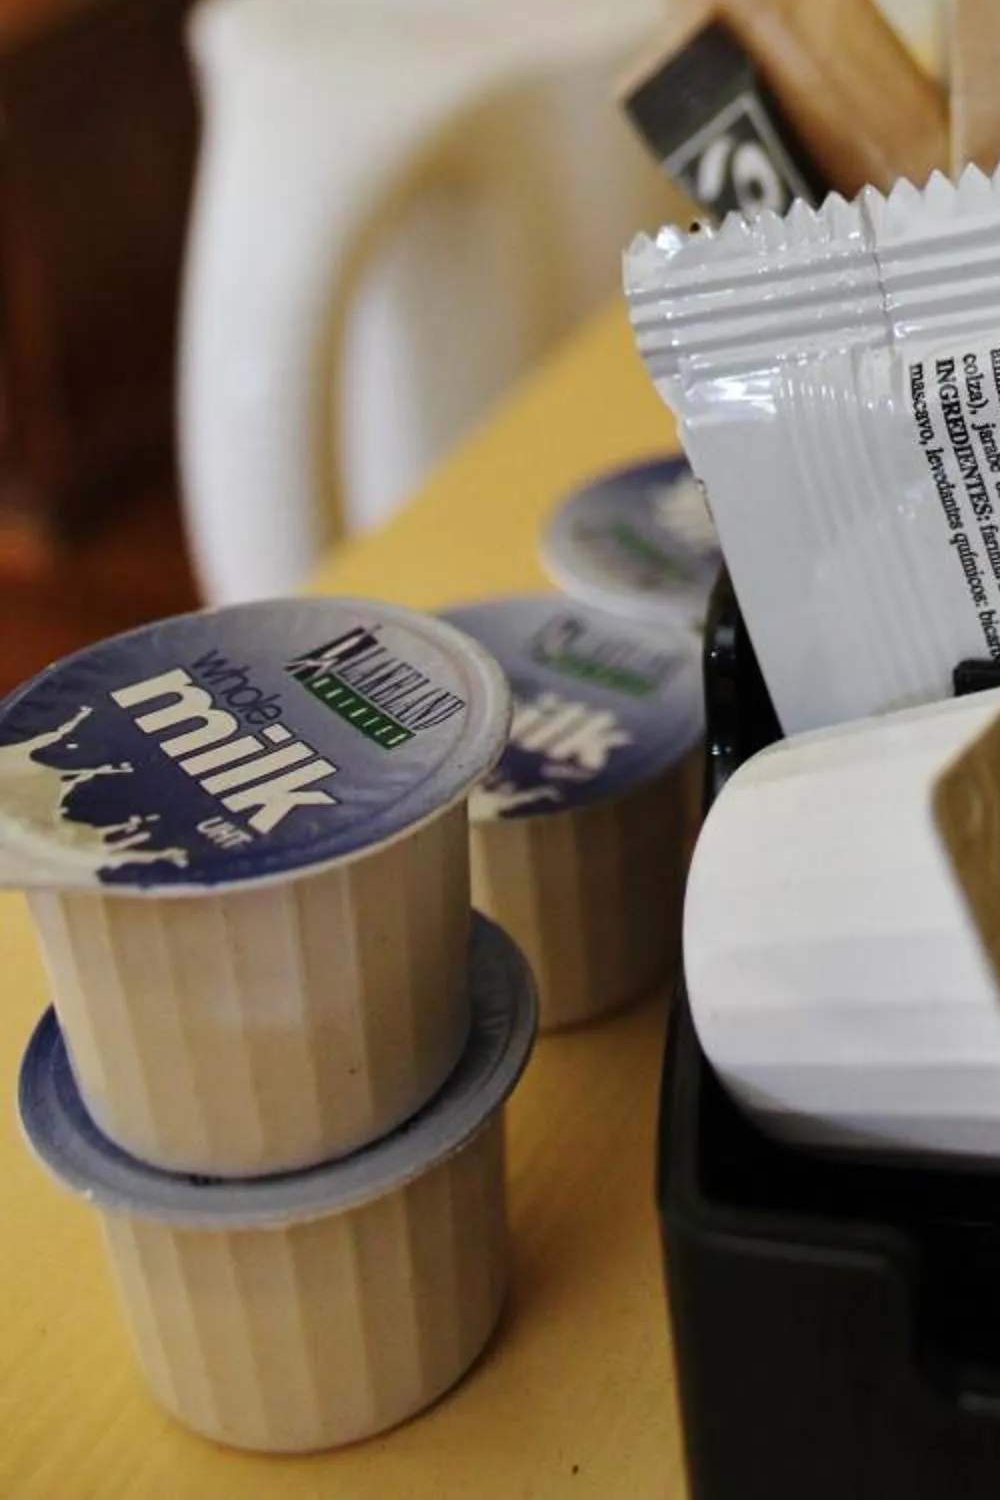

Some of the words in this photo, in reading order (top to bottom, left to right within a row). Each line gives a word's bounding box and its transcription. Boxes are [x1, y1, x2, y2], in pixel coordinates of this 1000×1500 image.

[936, 357, 994, 522] INGREDIENTES:
[963, 353, 989, 415] colza),
[909, 362, 934, 446] mascavo,
[925, 447, 964, 530] levedantes
[949, 532, 988, 607] químicos:
[191, 649, 283, 725] whole
[339, 647, 466, 732] LAKELAND
[109, 667, 342, 835] milk
